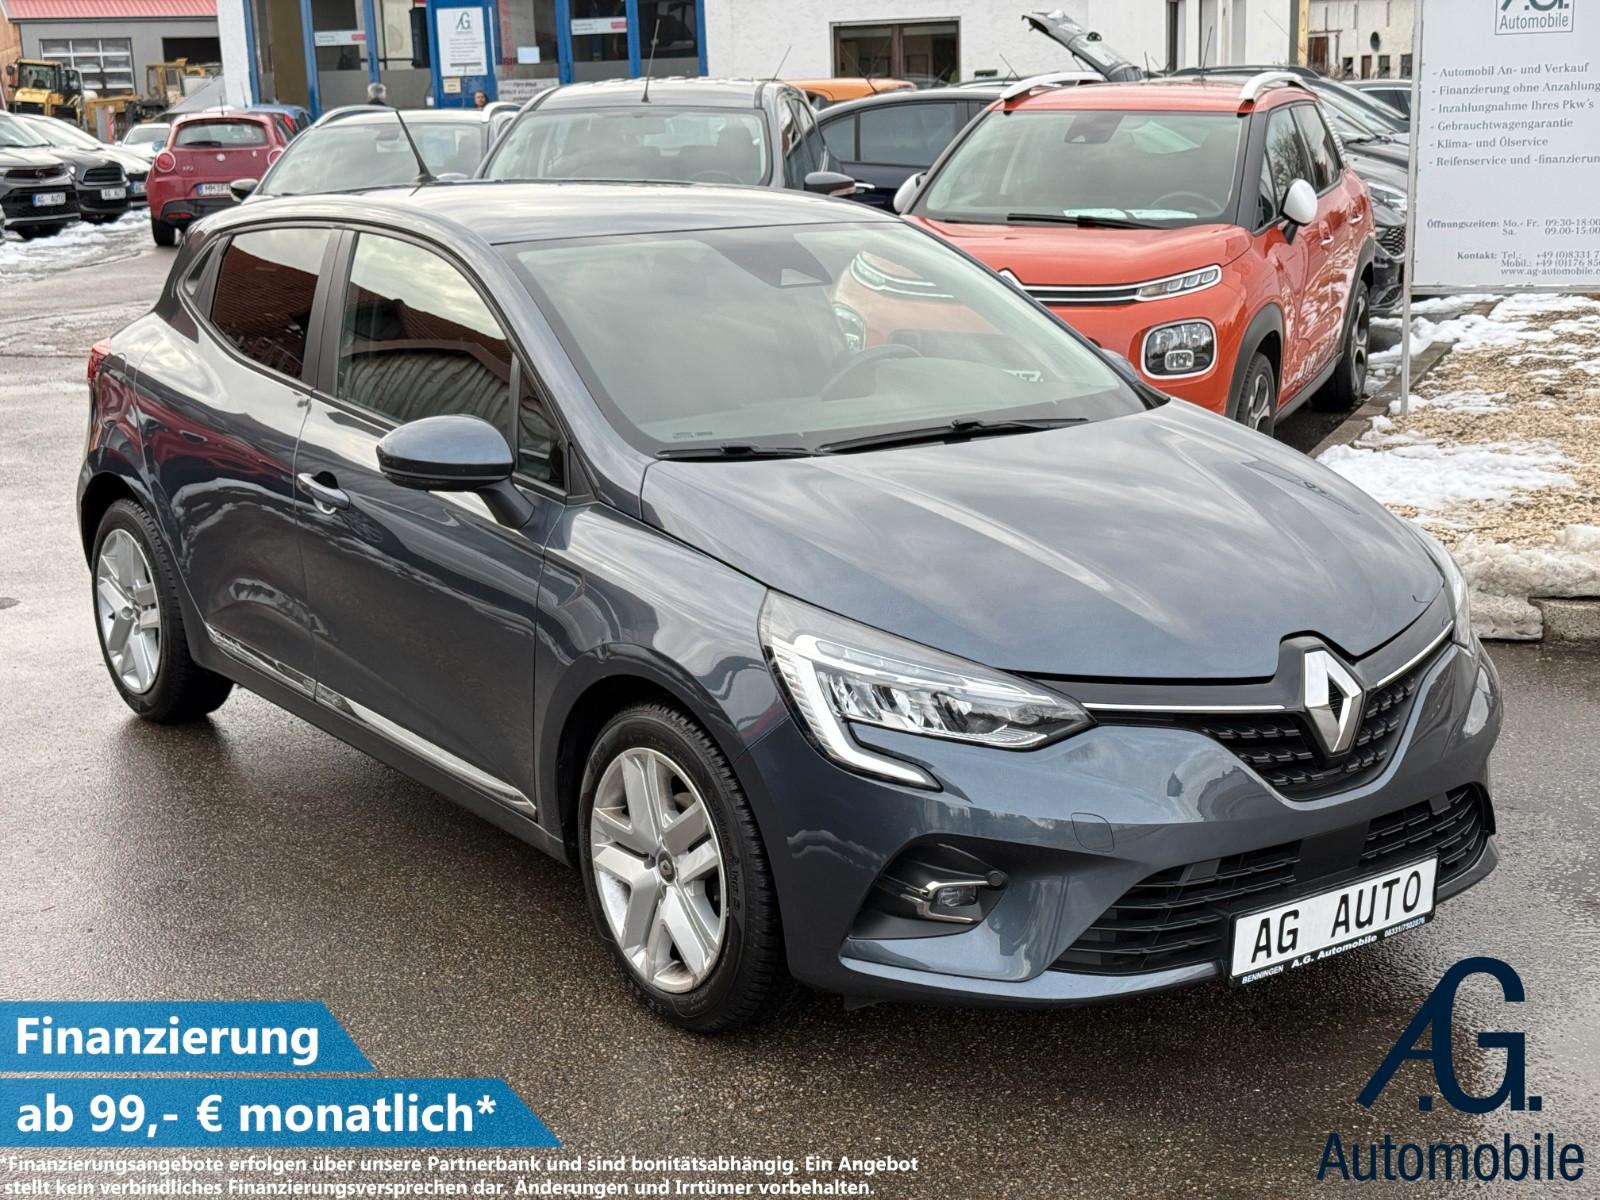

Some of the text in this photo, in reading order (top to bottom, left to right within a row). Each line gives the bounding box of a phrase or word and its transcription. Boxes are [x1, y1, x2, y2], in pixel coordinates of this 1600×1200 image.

[1499, 12, 1569, 30] Automobile
[1440, 62, 1590, 78] Automobil An- und Verkauf
[1440, 84, 1511, 96] Finanzierung
[1513, 82, 1540, 93] ohne
[1438, 101, 1528, 114] Inzahlungnahme
[1531, 100, 1560, 111] Ihres
[1437, 118, 1574, 131] Gebrauchtwagengarantie
[1437, 135, 1549, 149] Klima- und Ölservice
[1436, 155, 1507, 167] Reifenservice
[1510, 154, 1531, 165] und
[1426, 218, 1500, 231] Öffnungszeiten:
[1456, 250, 1498, 260] Kontakt:
[1250, 870, 1422, 964] AG AUTO
[1241, 964, 1284, 985] BENNINGEN
[1291, 954, 1315, 970] A.G.
[1317, 934, 1378, 960] Automobile
